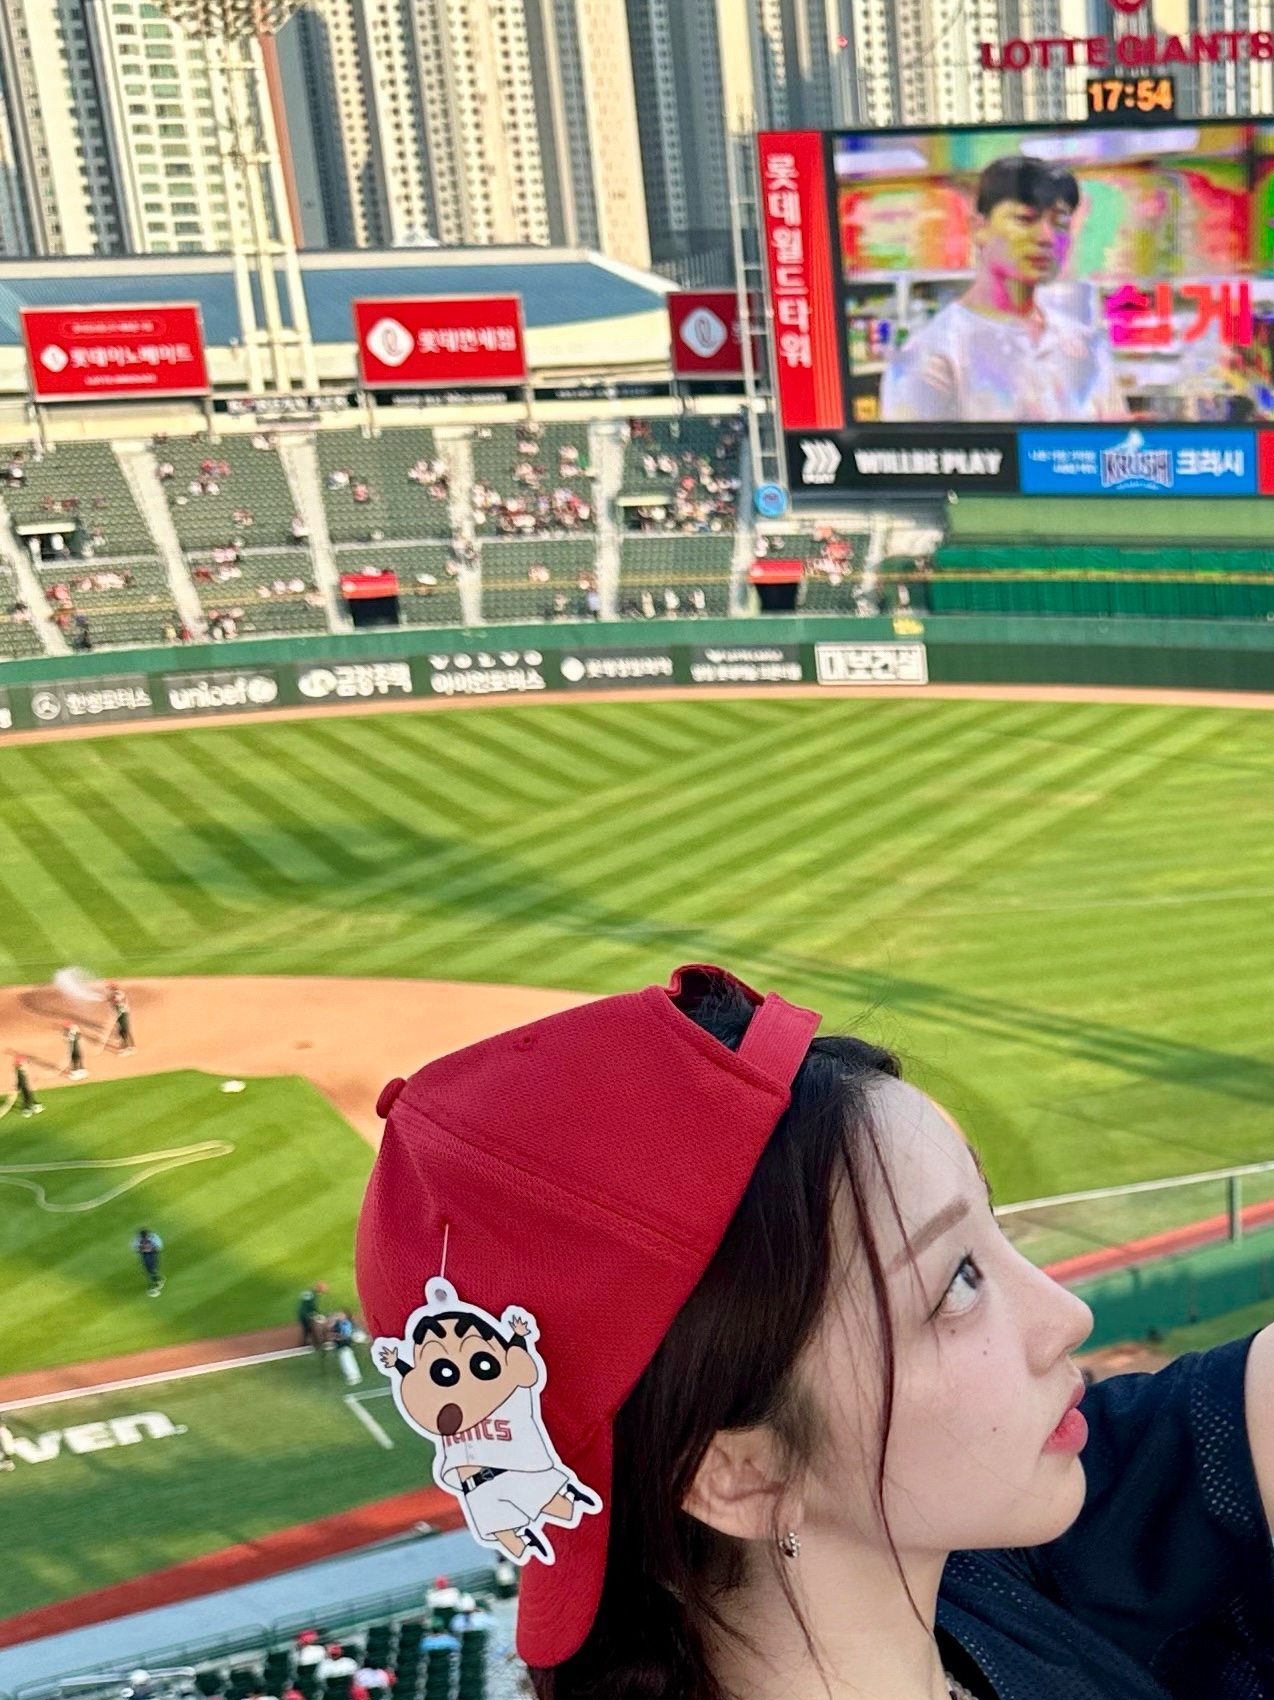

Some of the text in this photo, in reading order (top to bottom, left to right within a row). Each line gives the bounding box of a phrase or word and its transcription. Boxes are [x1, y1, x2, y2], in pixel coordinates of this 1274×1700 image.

[981, 35, 1109, 71] LOTTE
[1088, 79, 1174, 112] 17:54
[429, 650, 543, 670] VOLVO
[168, 676, 249, 710] unicef
